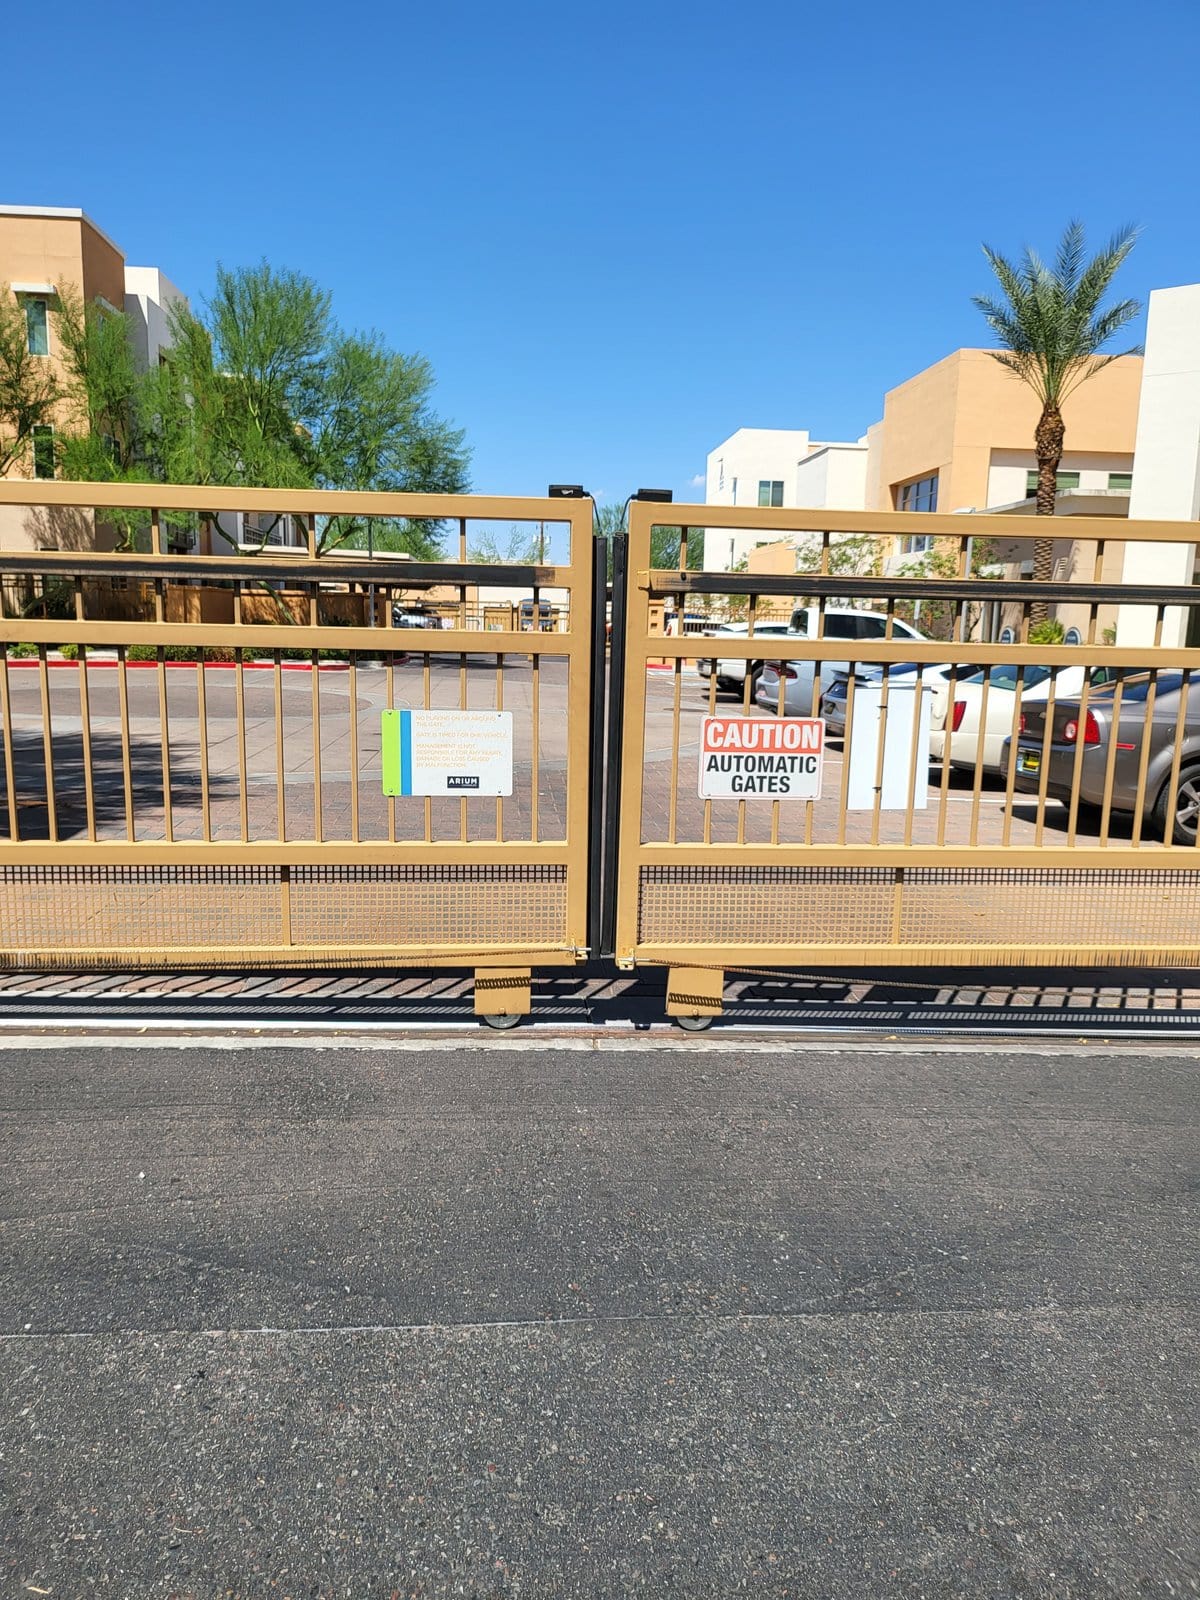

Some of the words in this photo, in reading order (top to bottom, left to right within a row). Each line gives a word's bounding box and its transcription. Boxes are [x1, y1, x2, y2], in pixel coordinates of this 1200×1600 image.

[707, 722, 819, 749] CAUTION
[706, 755, 817, 773] AUTOMATIC
[731, 775, 791, 793] GATES
